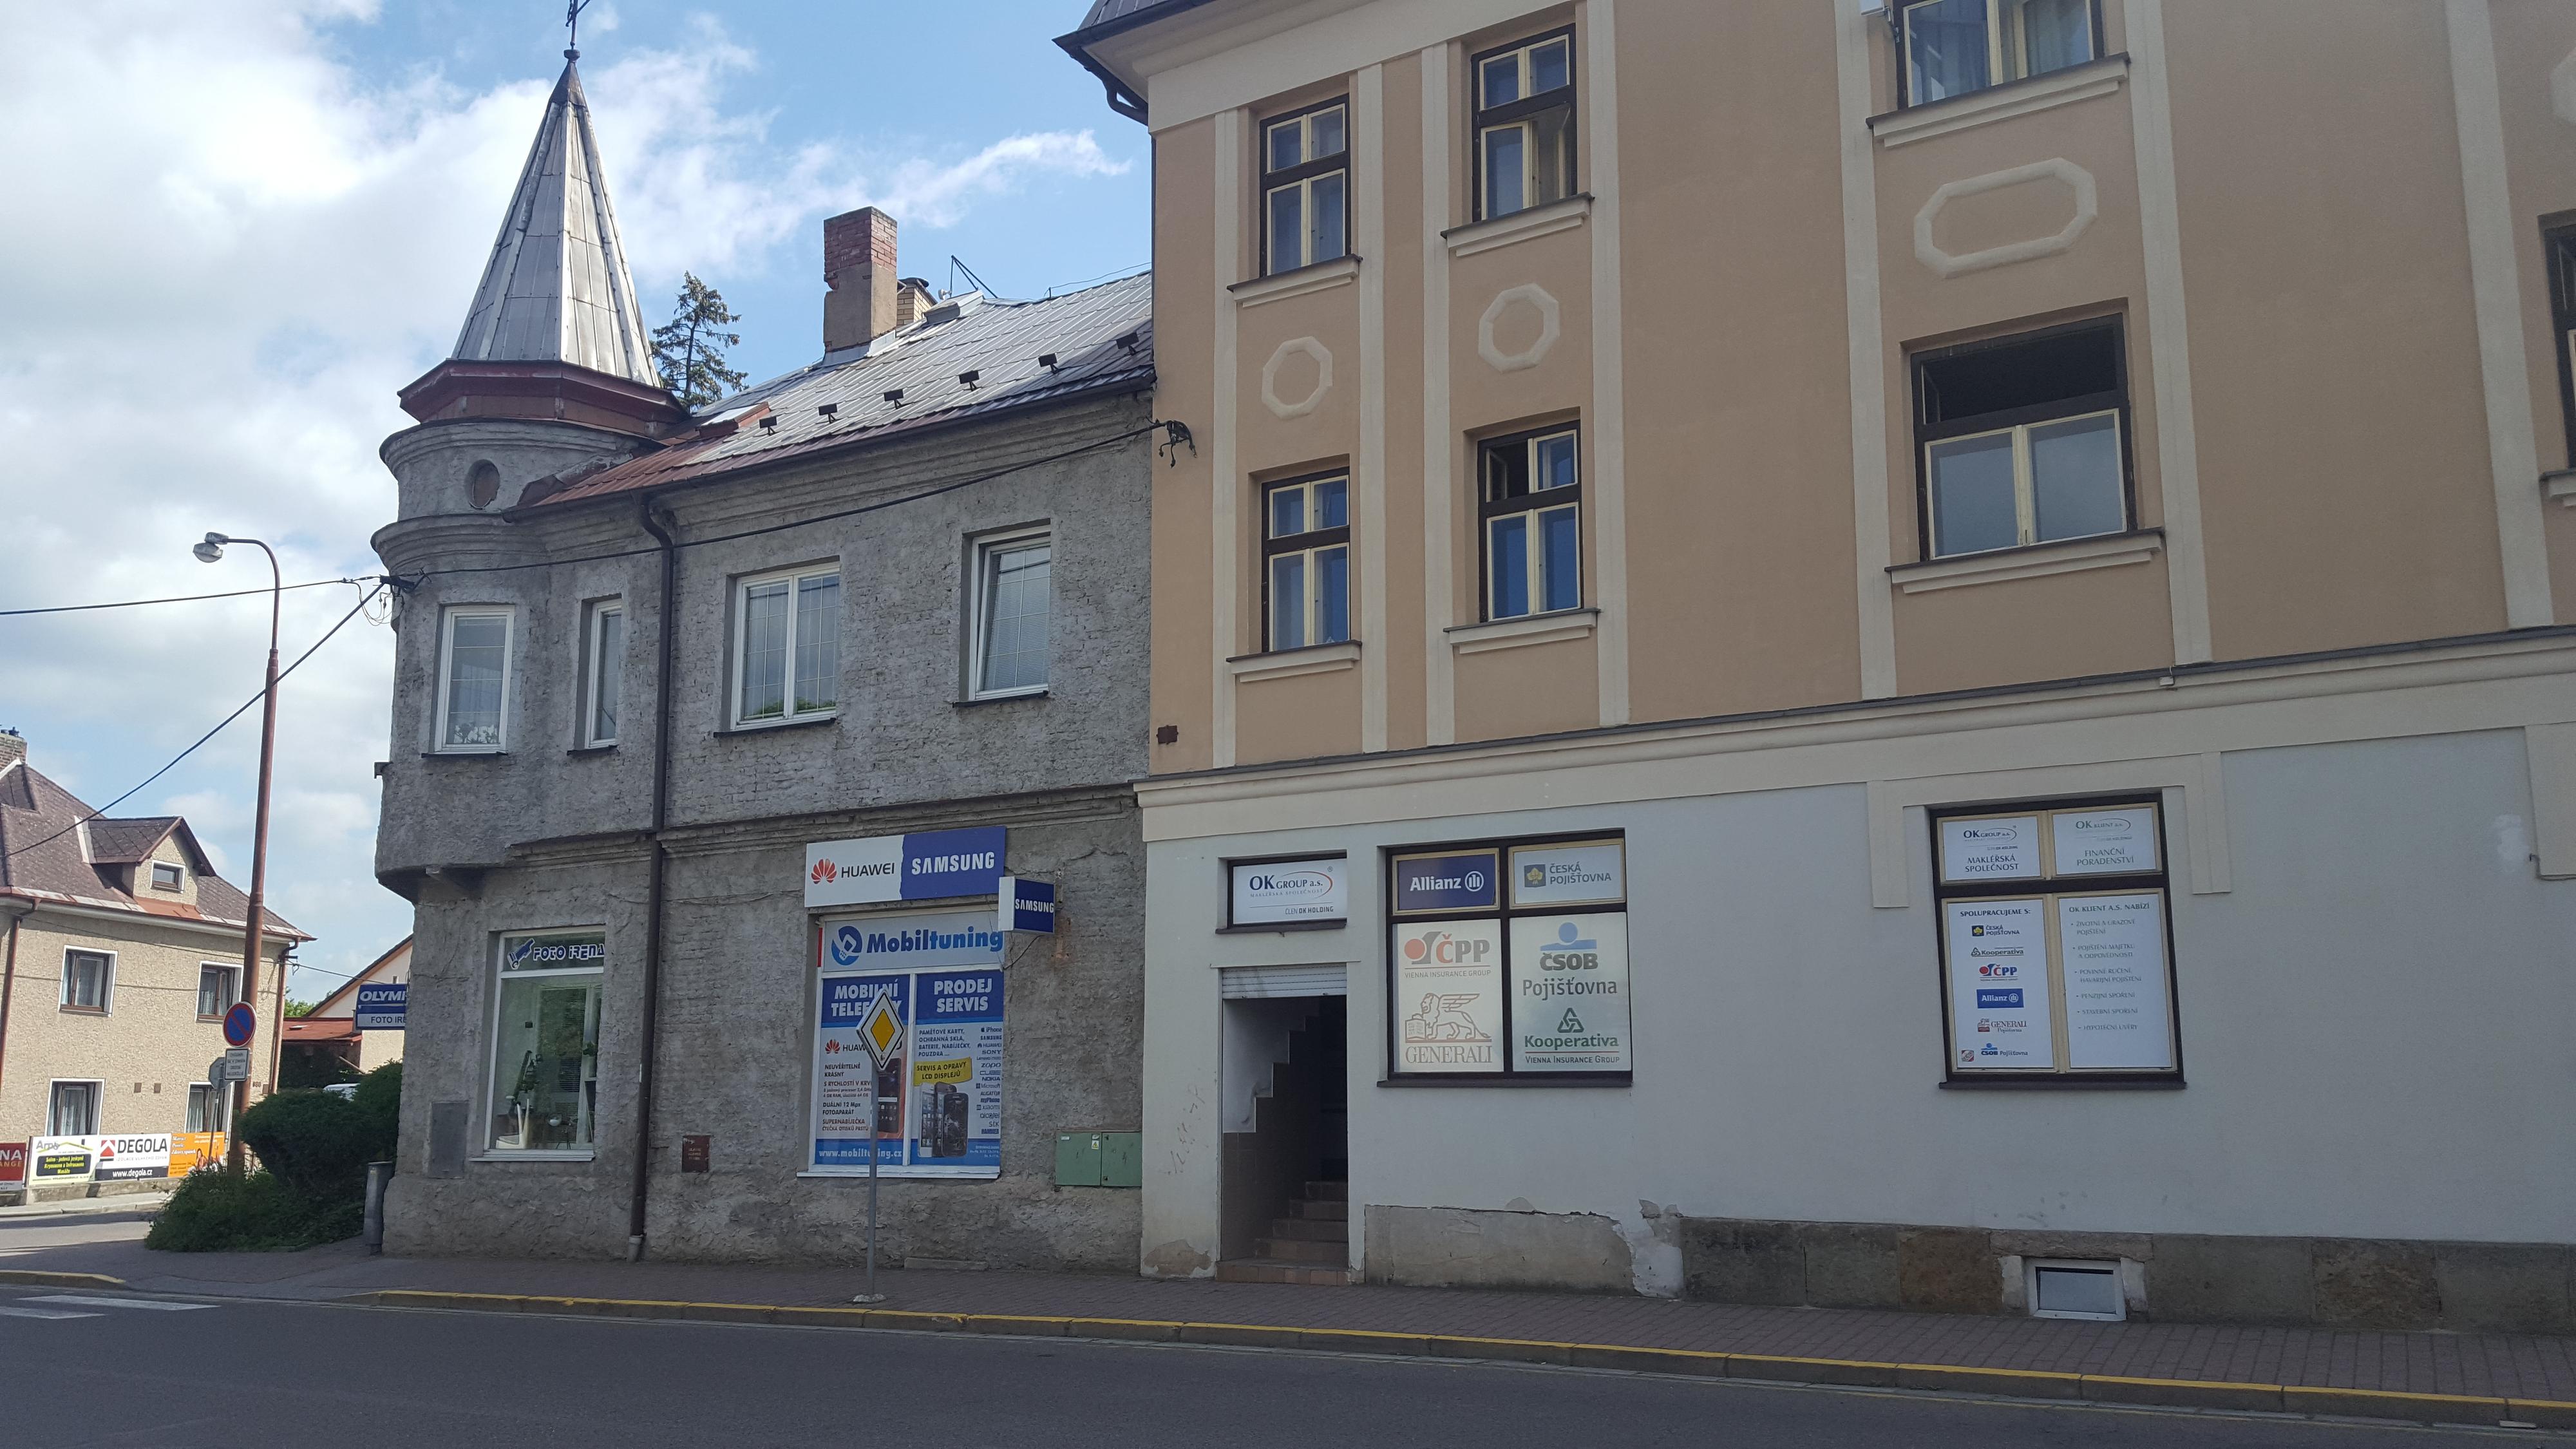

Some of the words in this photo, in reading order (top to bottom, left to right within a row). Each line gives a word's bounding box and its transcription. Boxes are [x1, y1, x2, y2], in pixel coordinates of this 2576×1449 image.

[2076, 820, 2092, 829] OK
[1963, 829, 1980, 838] OK
[1967, 853, 2016, 864] MAKLÉŘSKÁ
[2085, 847, 2125, 857] FINANČNÍ
[911, 851, 995, 876] SAMSUNG
[1549, 862, 1582, 873] ČESKÁ
[2076, 855, 2134, 866] PORADENSTVÍ
[840, 862, 895, 878] HUAWEI
[1965, 863, 2020, 873] SPOLEČNOST
[1249, 875, 1275, 891] OK
[1276, 879, 1307, 889] GROUP
[1410, 876, 1462, 892] Allianz
[1549, 871, 1612, 885] POJIŠŤOVNA
[1014, 898, 1054, 914] SAMSUNG
[1960, 909, 2022, 917] SPOLUPRACUJEME
[2125, 902, 2150, 910] NABÍZÍ
[866, 925, 1004, 954] Mobiltuning
[533, 945, 566, 961] FOTO
[1435, 933, 1490, 964] ČPP
[1539, 952, 1598, 971] ČSOB
[1993, 964, 2018, 976] ČPP
[934, 978, 992, 995] PRODEJ
[1522, 977, 1618, 1001] Pojišťovna
[831, 1000, 902, 1017] TELEFY
[936, 996, 989, 1012] SERVIS
[842, 1043, 866, 1052] HUAW
[1524, 1033, 1619, 1050] Kooperativa
[1405, 1045, 1493, 1064] GENERALI
[943, 1061, 967, 1070] OPRAVY
[934, 1070, 961, 1079] DISPLEJŮ
[118, 1138, 167, 1153] DEGOLA
[819, 1148, 902, 1159] www.mobilting.cz
[112, 1169, 153, 1177] www.degola.cz
